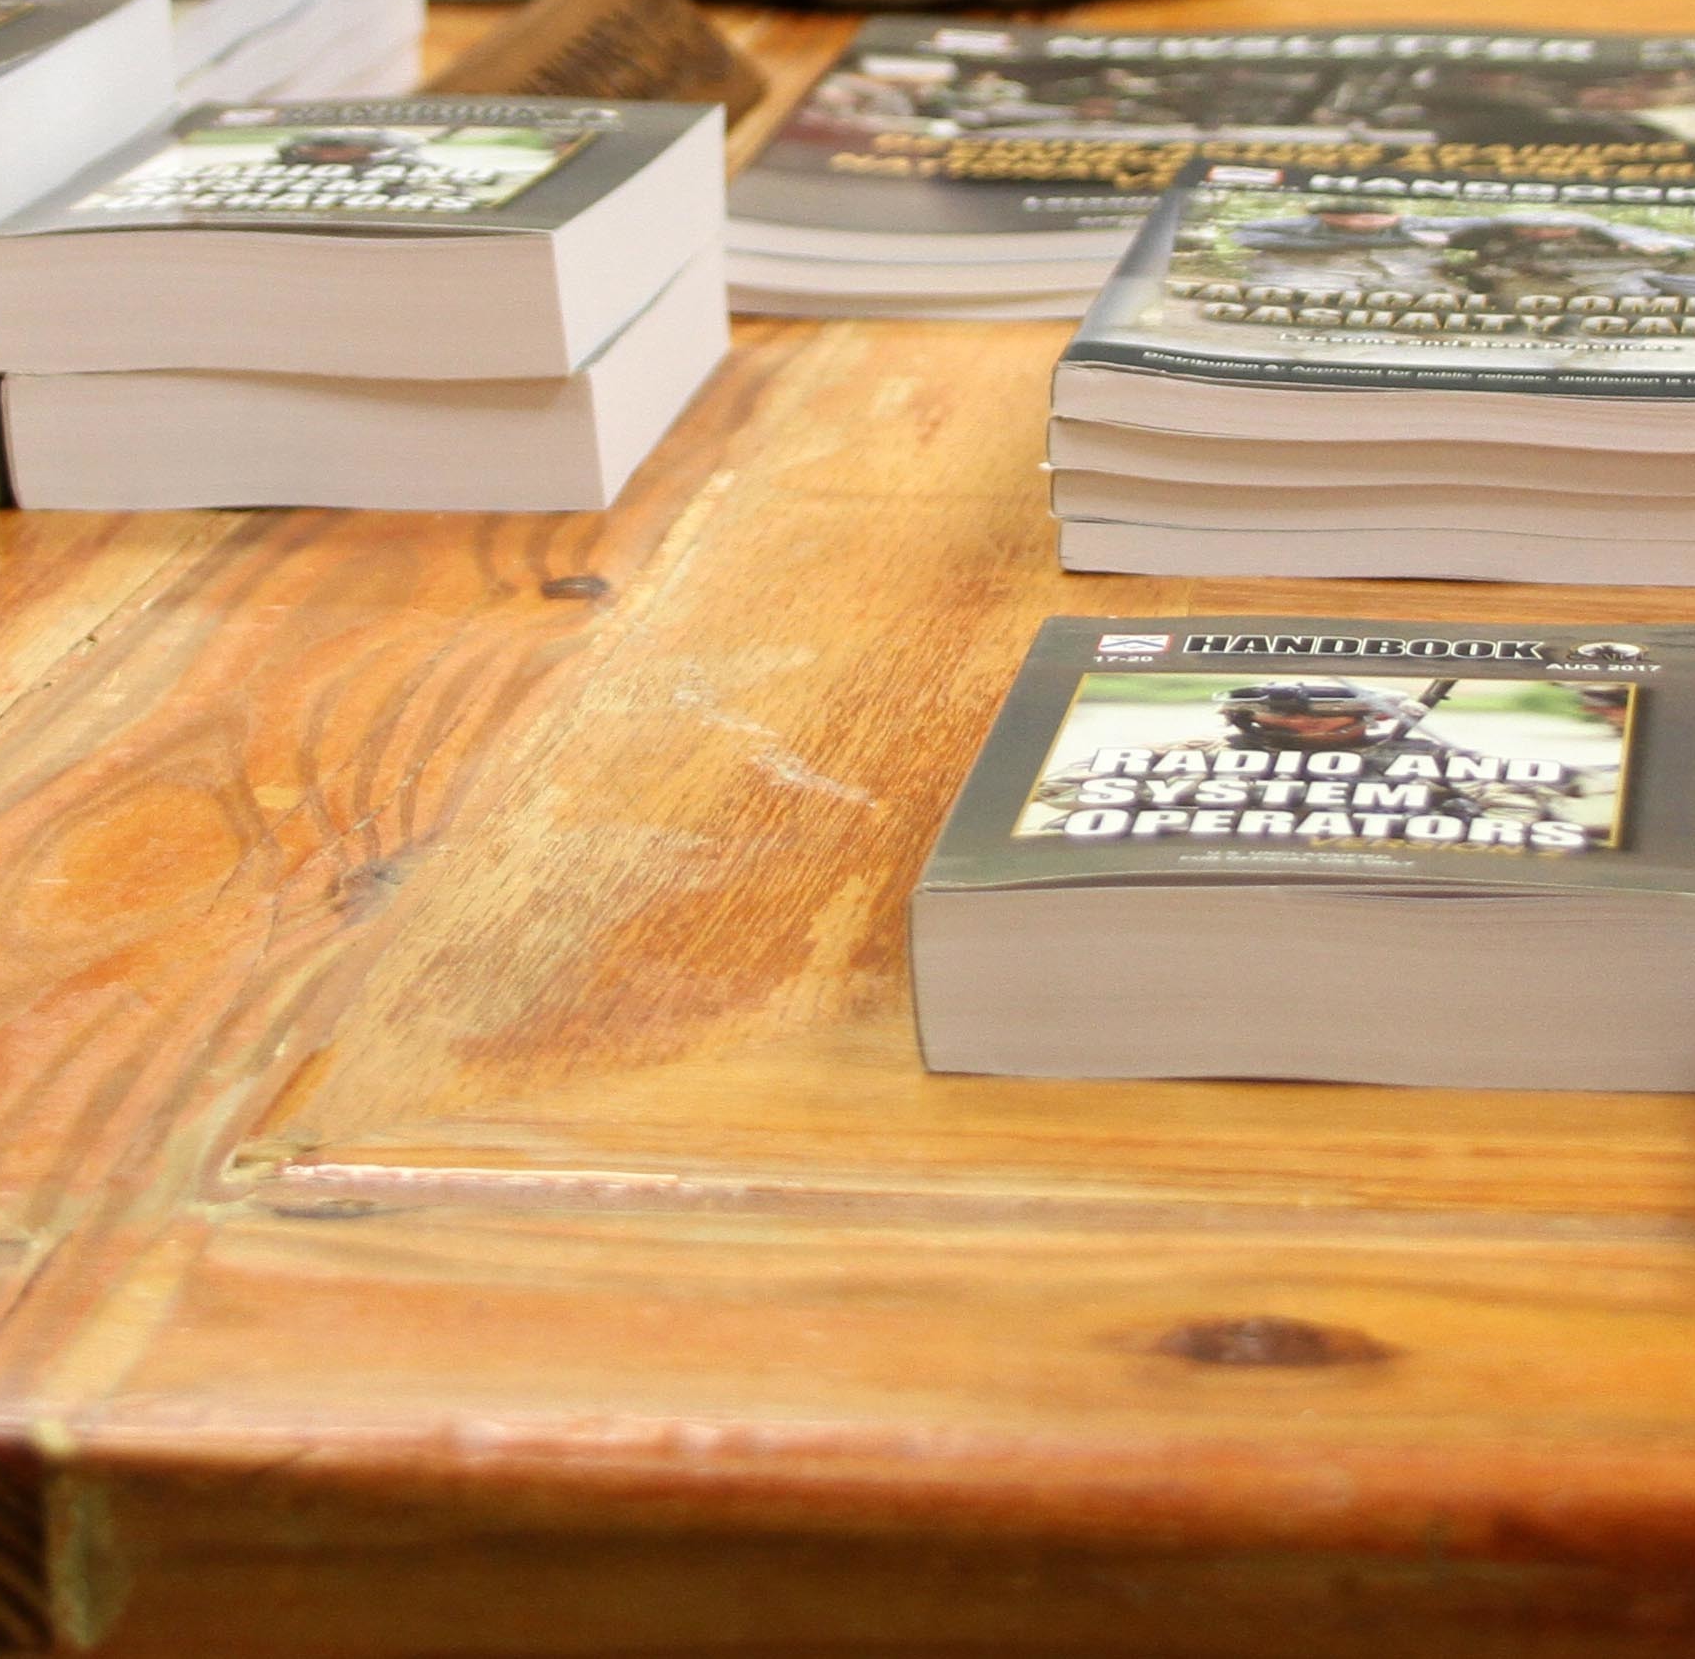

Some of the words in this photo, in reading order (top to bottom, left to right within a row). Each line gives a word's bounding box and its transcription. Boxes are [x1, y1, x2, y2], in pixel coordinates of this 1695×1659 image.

[1170, 282, 1497, 312] TACTICAL
[1201, 301, 1565, 333] CASUALTY
[1407, 339, 1460, 347] and
[1143, 351, 1260, 370] Distribution
[1290, 364, 1382, 376] Approved
[1557, 374, 1662, 384] distribution
[1093, 655, 1154, 663] 17-20
[1182, 634, 1545, 660] HANDBOOK
[1545, 662, 1601, 672] AUG
[1608, 663, 1662, 673] 2017
[1090, 747, 1363, 775] RADIO
[1383, 753, 1564, 782] AND
[1077, 777, 1429, 809] SYSTEM
[1063, 808, 1587, 848] OPERATORS
